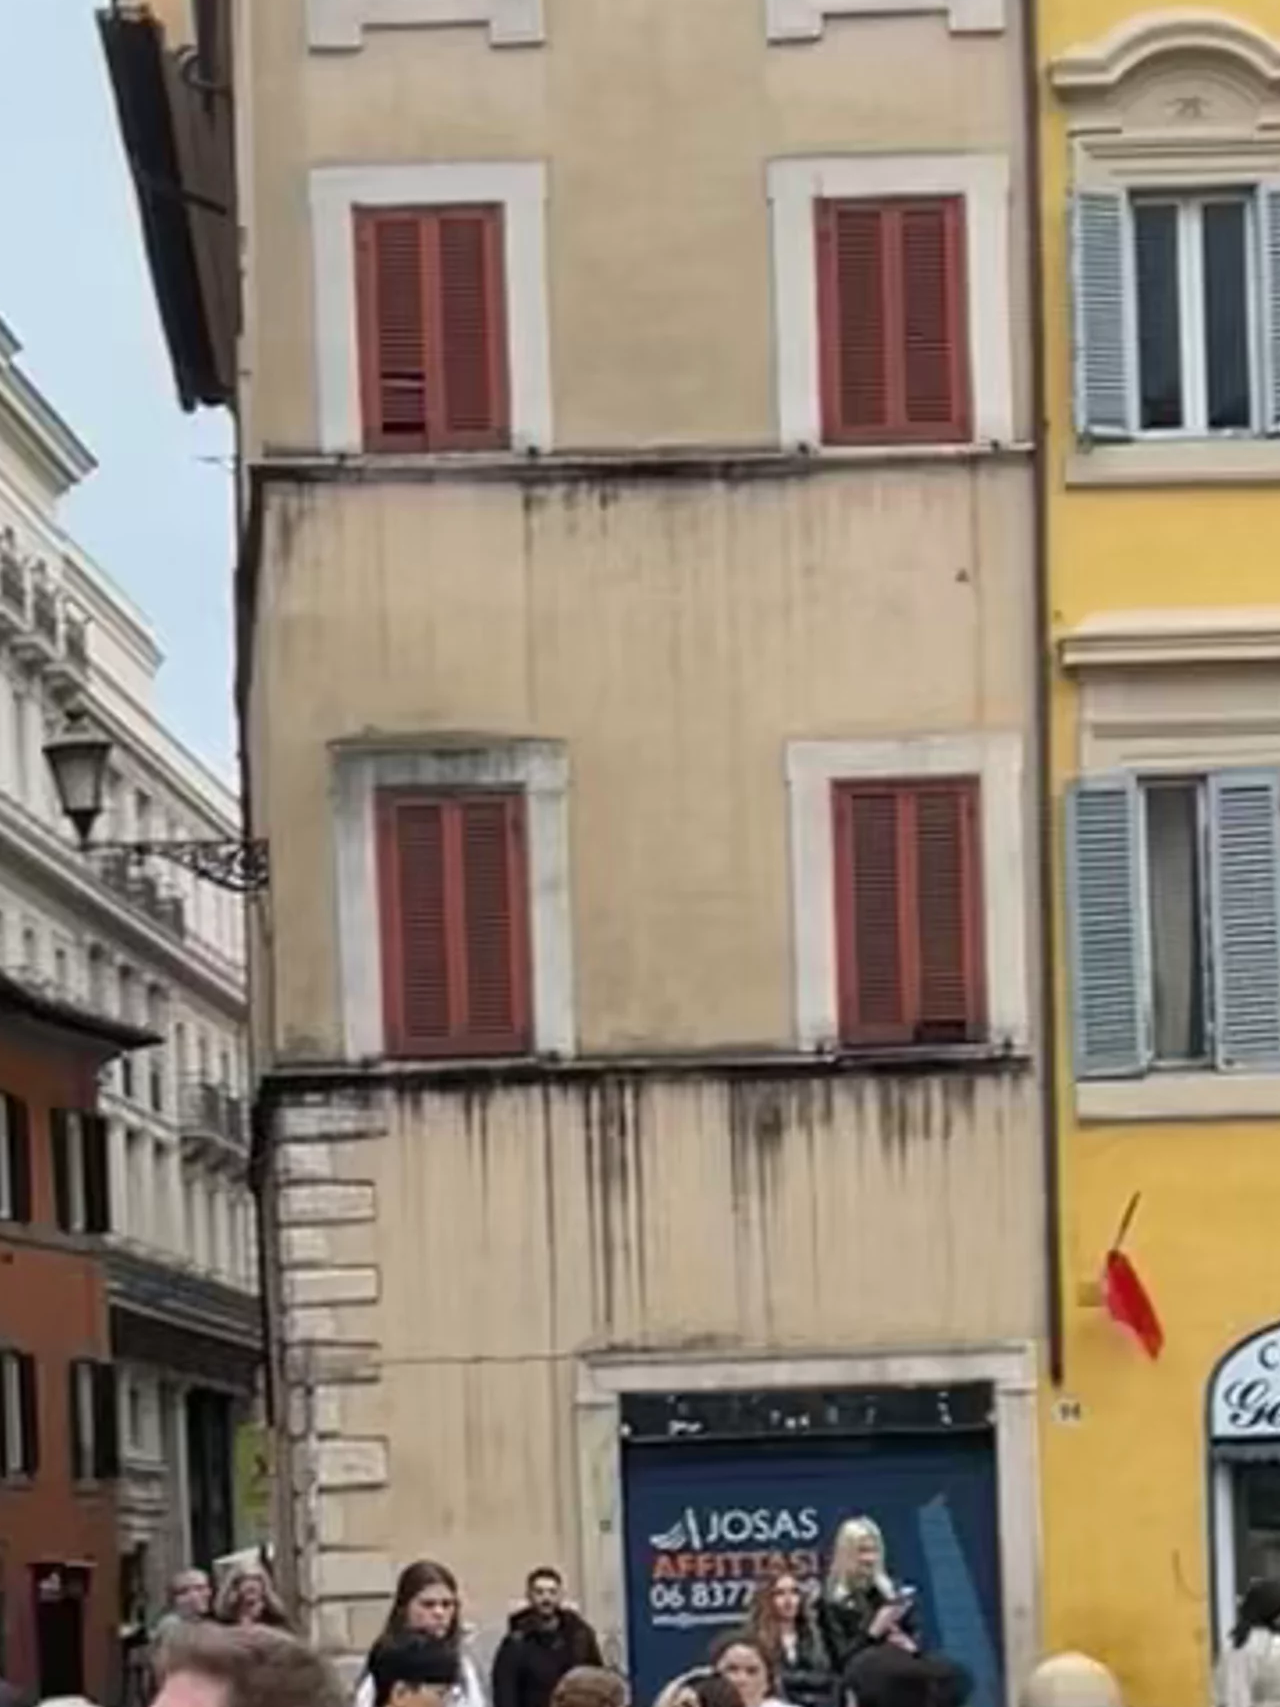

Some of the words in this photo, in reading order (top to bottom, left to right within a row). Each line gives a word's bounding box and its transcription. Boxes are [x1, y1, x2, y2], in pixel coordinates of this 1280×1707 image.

[706, 1507, 819, 1543] JOSAS
[651, 1549, 820, 1579] AFFITTASI
[650, 1583, 686, 1610] 06
